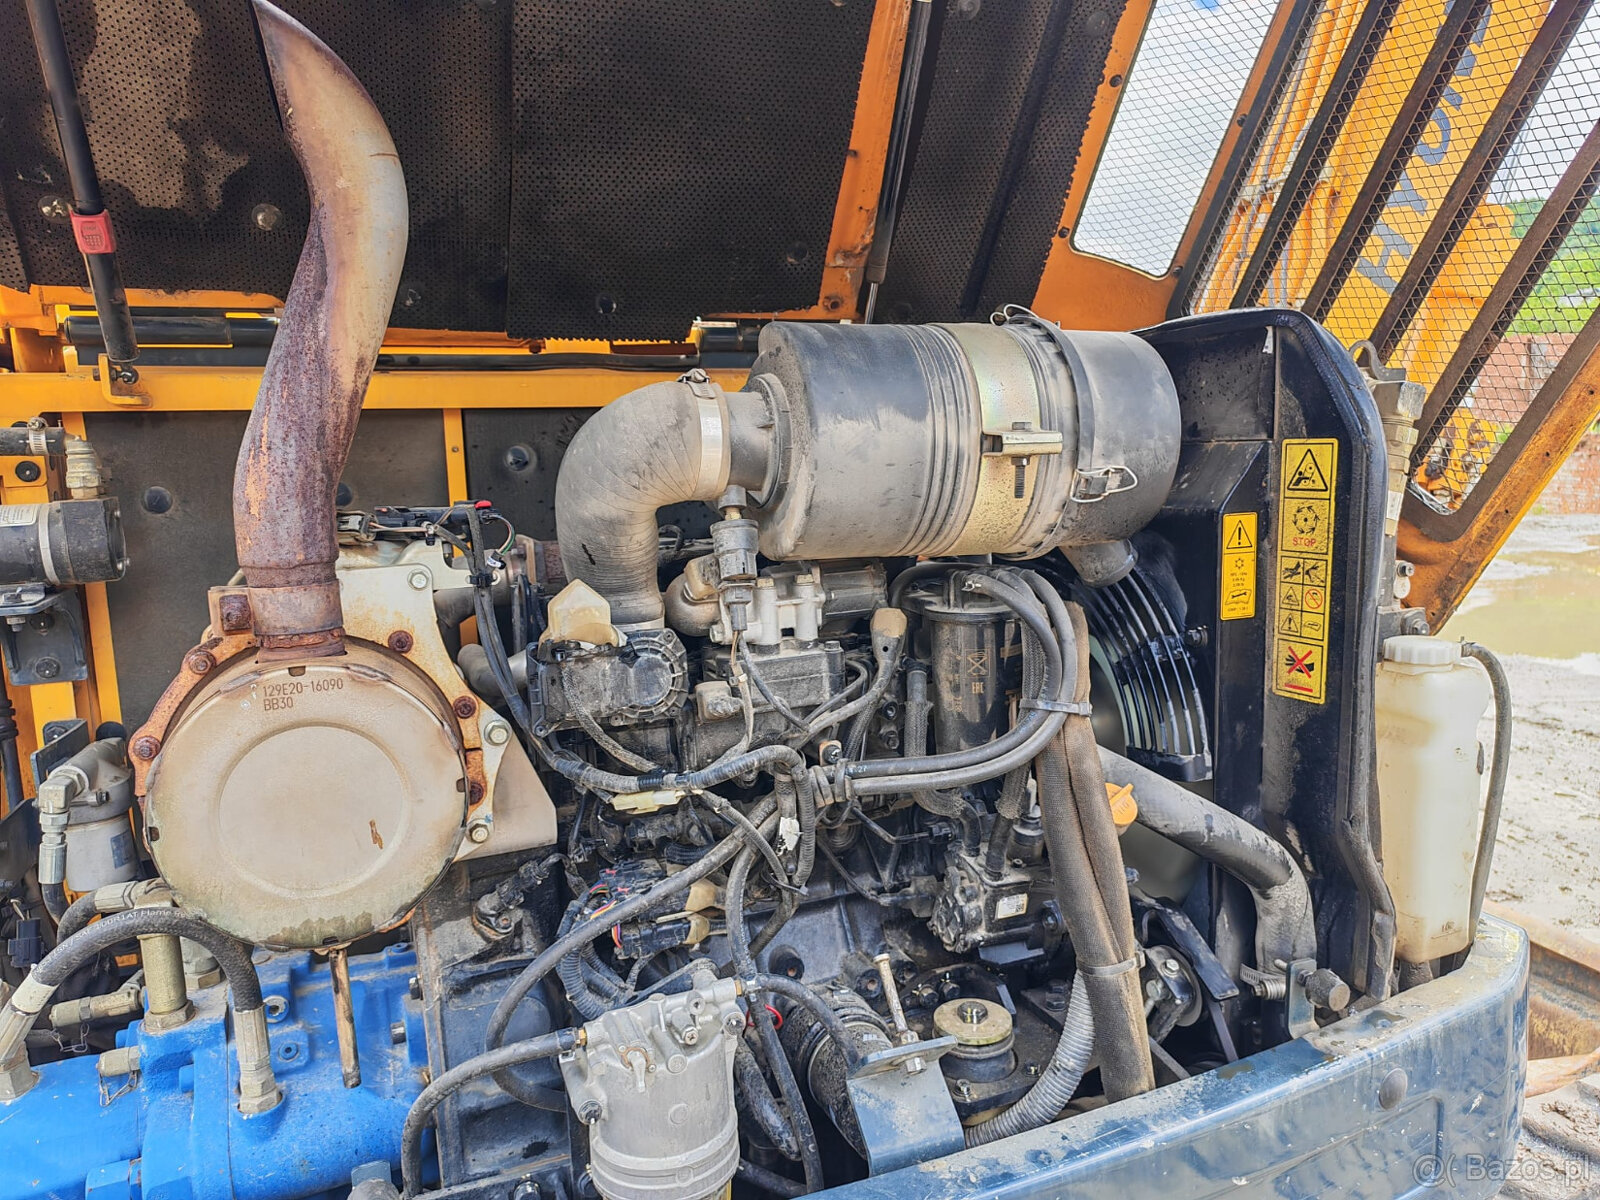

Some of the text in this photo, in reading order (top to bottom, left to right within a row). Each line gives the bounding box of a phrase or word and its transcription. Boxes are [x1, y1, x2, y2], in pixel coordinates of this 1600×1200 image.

[1292, 536, 1316, 547] STOP
[263, 678, 344, 697] 129E20-16090
[263, 697, 294, 711] BB30
[140, 909, 172, 918] Flame
